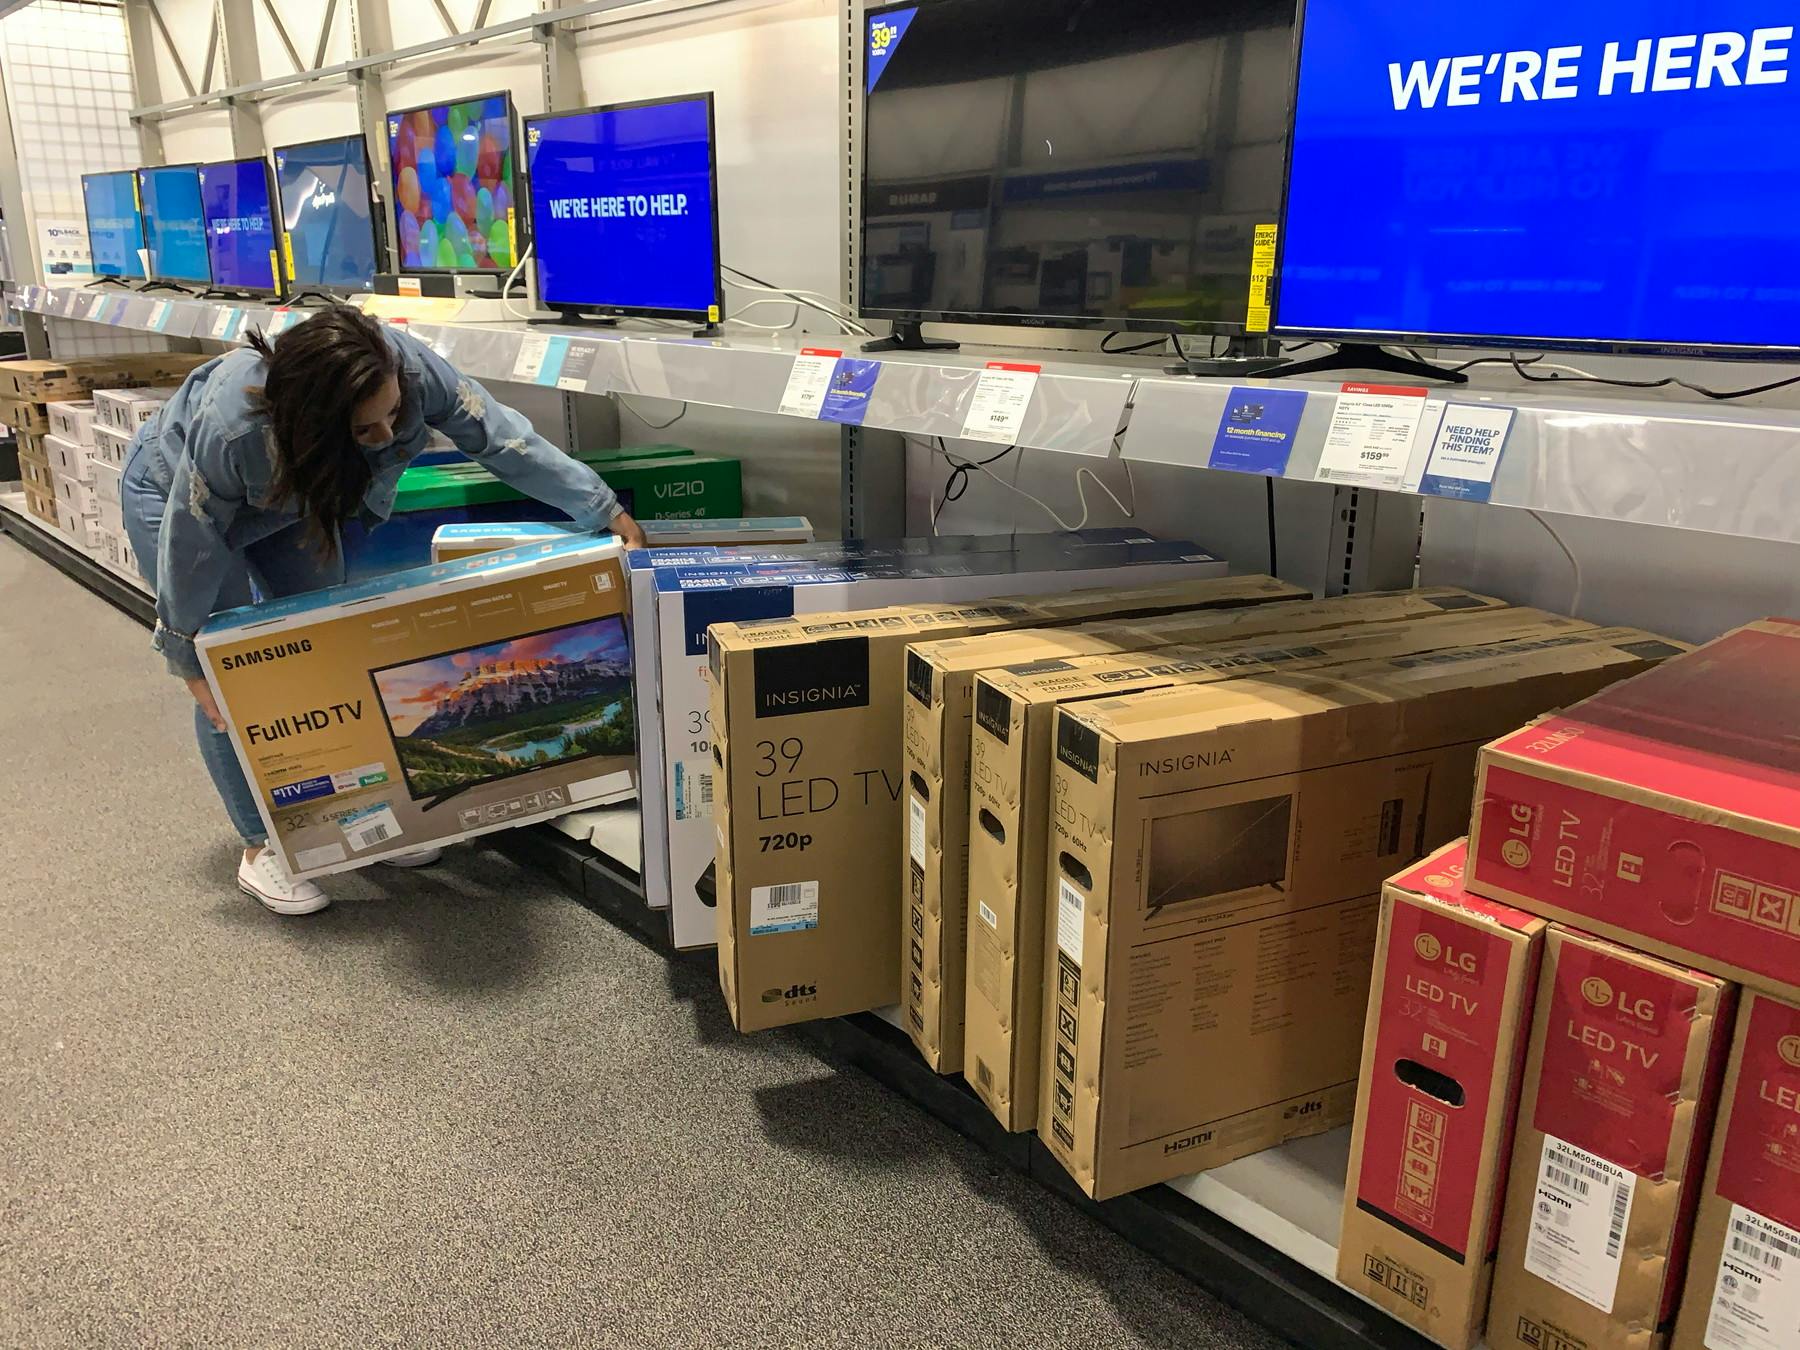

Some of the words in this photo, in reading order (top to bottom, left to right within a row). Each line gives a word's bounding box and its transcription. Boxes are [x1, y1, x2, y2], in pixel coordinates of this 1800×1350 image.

[1388, 45, 1583, 111] WE'RE
[1598, 26, 1794, 96] HERE
[550, 198, 589, 219] WE'RE
[591, 197, 626, 218] HERE
[627, 195, 648, 217] TO
[650, 194, 688, 216] HELP.
[241, 217, 250, 231] TO
[1255, 231, 1276, 240] ENERGY
[1346, 386, 1369, 394] SAVINGS
[1234, 428, 1255, 436] month
[1255, 429, 1287, 441] financing
[1445, 424, 1473, 435] NEED
[1474, 427, 1501, 439] HELP
[1448, 433, 1491, 447] FINDING
[1441, 441, 1463, 453] THIS
[1464, 444, 1495, 456] ITEM?
[654, 480, 705, 499] VIZIO
[743, 628, 790, 639] FRAGILE
[221, 639, 313, 671] SAMSUNG
[1033, 675, 1082, 687] FRAGILE
[1041, 681, 1089, 693] FRAGILE
[766, 684, 857, 707] INSIGNIA
[246, 717, 292, 746] Full
[291, 709, 330, 735] HD
[329, 700, 362, 724] TV
[978, 711, 1008, 736] INSIGNIA
[755, 737, 804, 777] 39
[975, 738, 986, 758] 39
[1060, 745, 1096, 774] INSIGNIA
[1139, 748, 1233, 778] INSIGNIA
[975, 759, 992, 784] LED
[994, 772, 1008, 796] TV
[1055, 774, 1068, 797] 39
[758, 777, 838, 820] LED
[853, 768, 903, 805] TV
[974, 781, 986, 798] 720p
[988, 793, 1001, 809] 60Hz
[330, 807, 359, 820] SERIES
[1054, 796, 1077, 825] LED
[1079, 812, 1097, 839] TV
[1509, 803, 1532, 838] LG
[1559, 809, 1581, 840] TV
[759, 831, 812, 852] 720p
[1054, 821, 1069, 839] 720p
[1072, 835, 1087, 853] 60Hz
[1553, 845, 1576, 888] LED
[1445, 946, 1477, 973] LG
[784, 984, 817, 1000] dts
[1405, 974, 1444, 1003] LED
[1449, 991, 1479, 1016] TV
[1617, 991, 1655, 1021] LG
[1567, 1020, 1616, 1052] LED
[1621, 1040, 1660, 1070] TV
[1299, 1100, 1323, 1116] dts
[1760, 1079, 1800, 1115] LE
[1164, 1131, 1212, 1154] HDMI
[1556, 1142, 1624, 1180] 32LM505BBUA
[1538, 1188, 1572, 1211] HDMI
[1744, 1213, 1800, 1247] 32LM505B
[1368, 1258, 1385, 1274] 10
[1722, 1260, 1762, 1285] HDMI
[1522, 1321, 1542, 1339] 10
